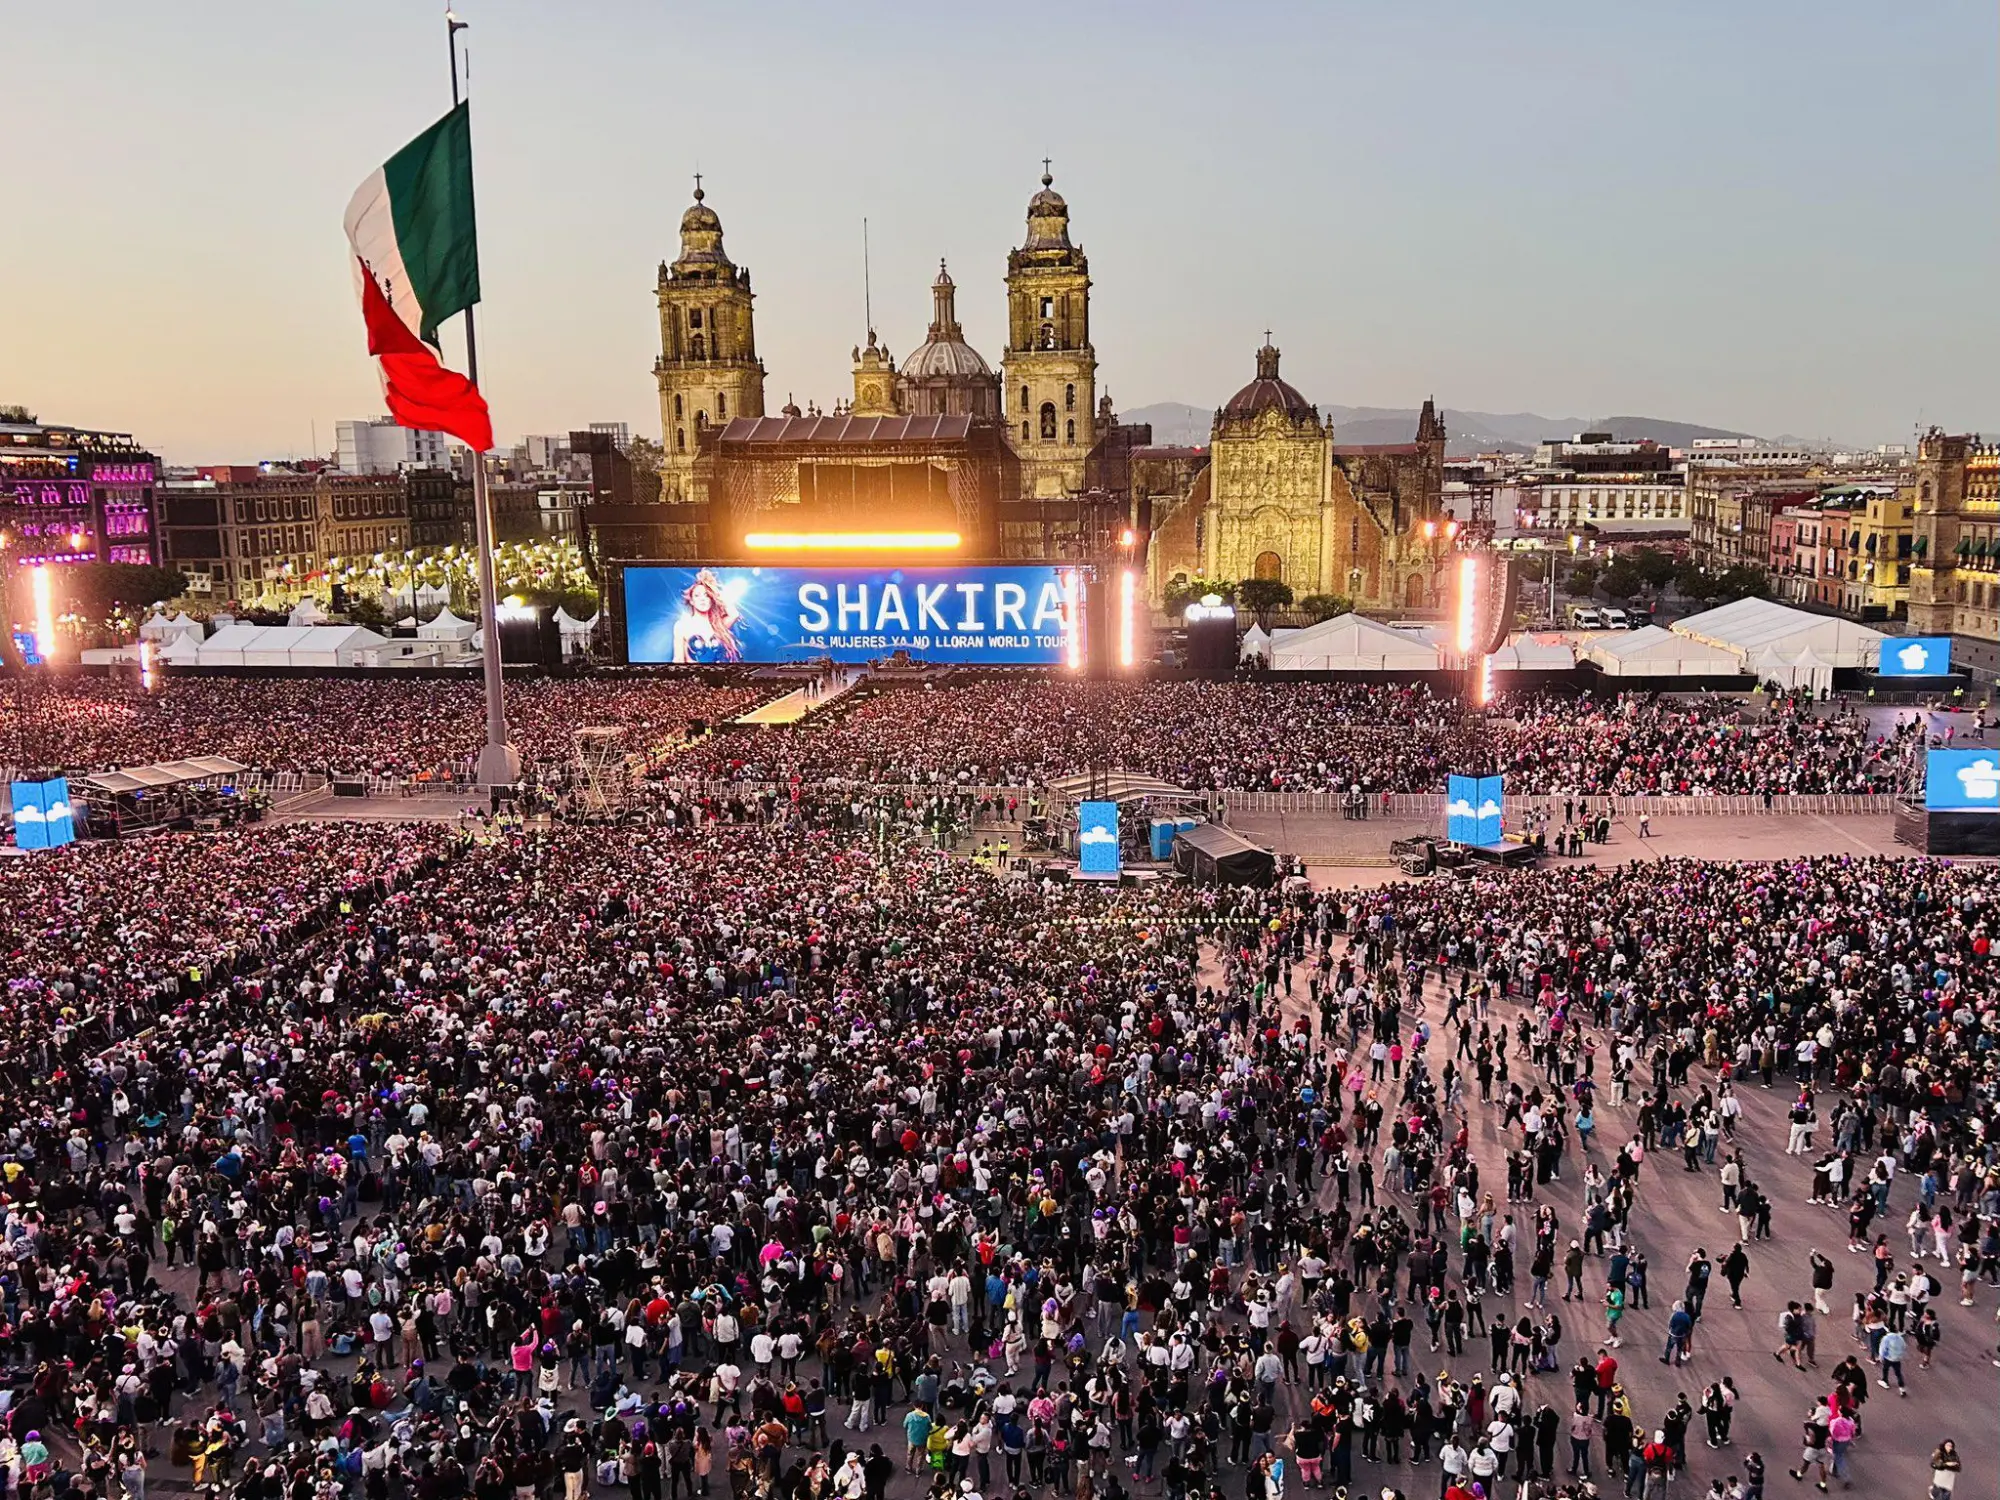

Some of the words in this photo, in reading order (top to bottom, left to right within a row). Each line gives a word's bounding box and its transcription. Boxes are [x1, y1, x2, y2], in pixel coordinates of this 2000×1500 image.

[798, 582, 1069, 632] SHAKIRA
[801, 635, 825, 648] LAS
[830, 635, 886, 648] MUJERES
[891, 635, 907, 648] YA
[913, 635, 930, 648] NO
[935, 635, 984, 648] LLORAN
[988, 635, 1030, 648] WORLD
[1035, 635, 1069, 648] TOUR
